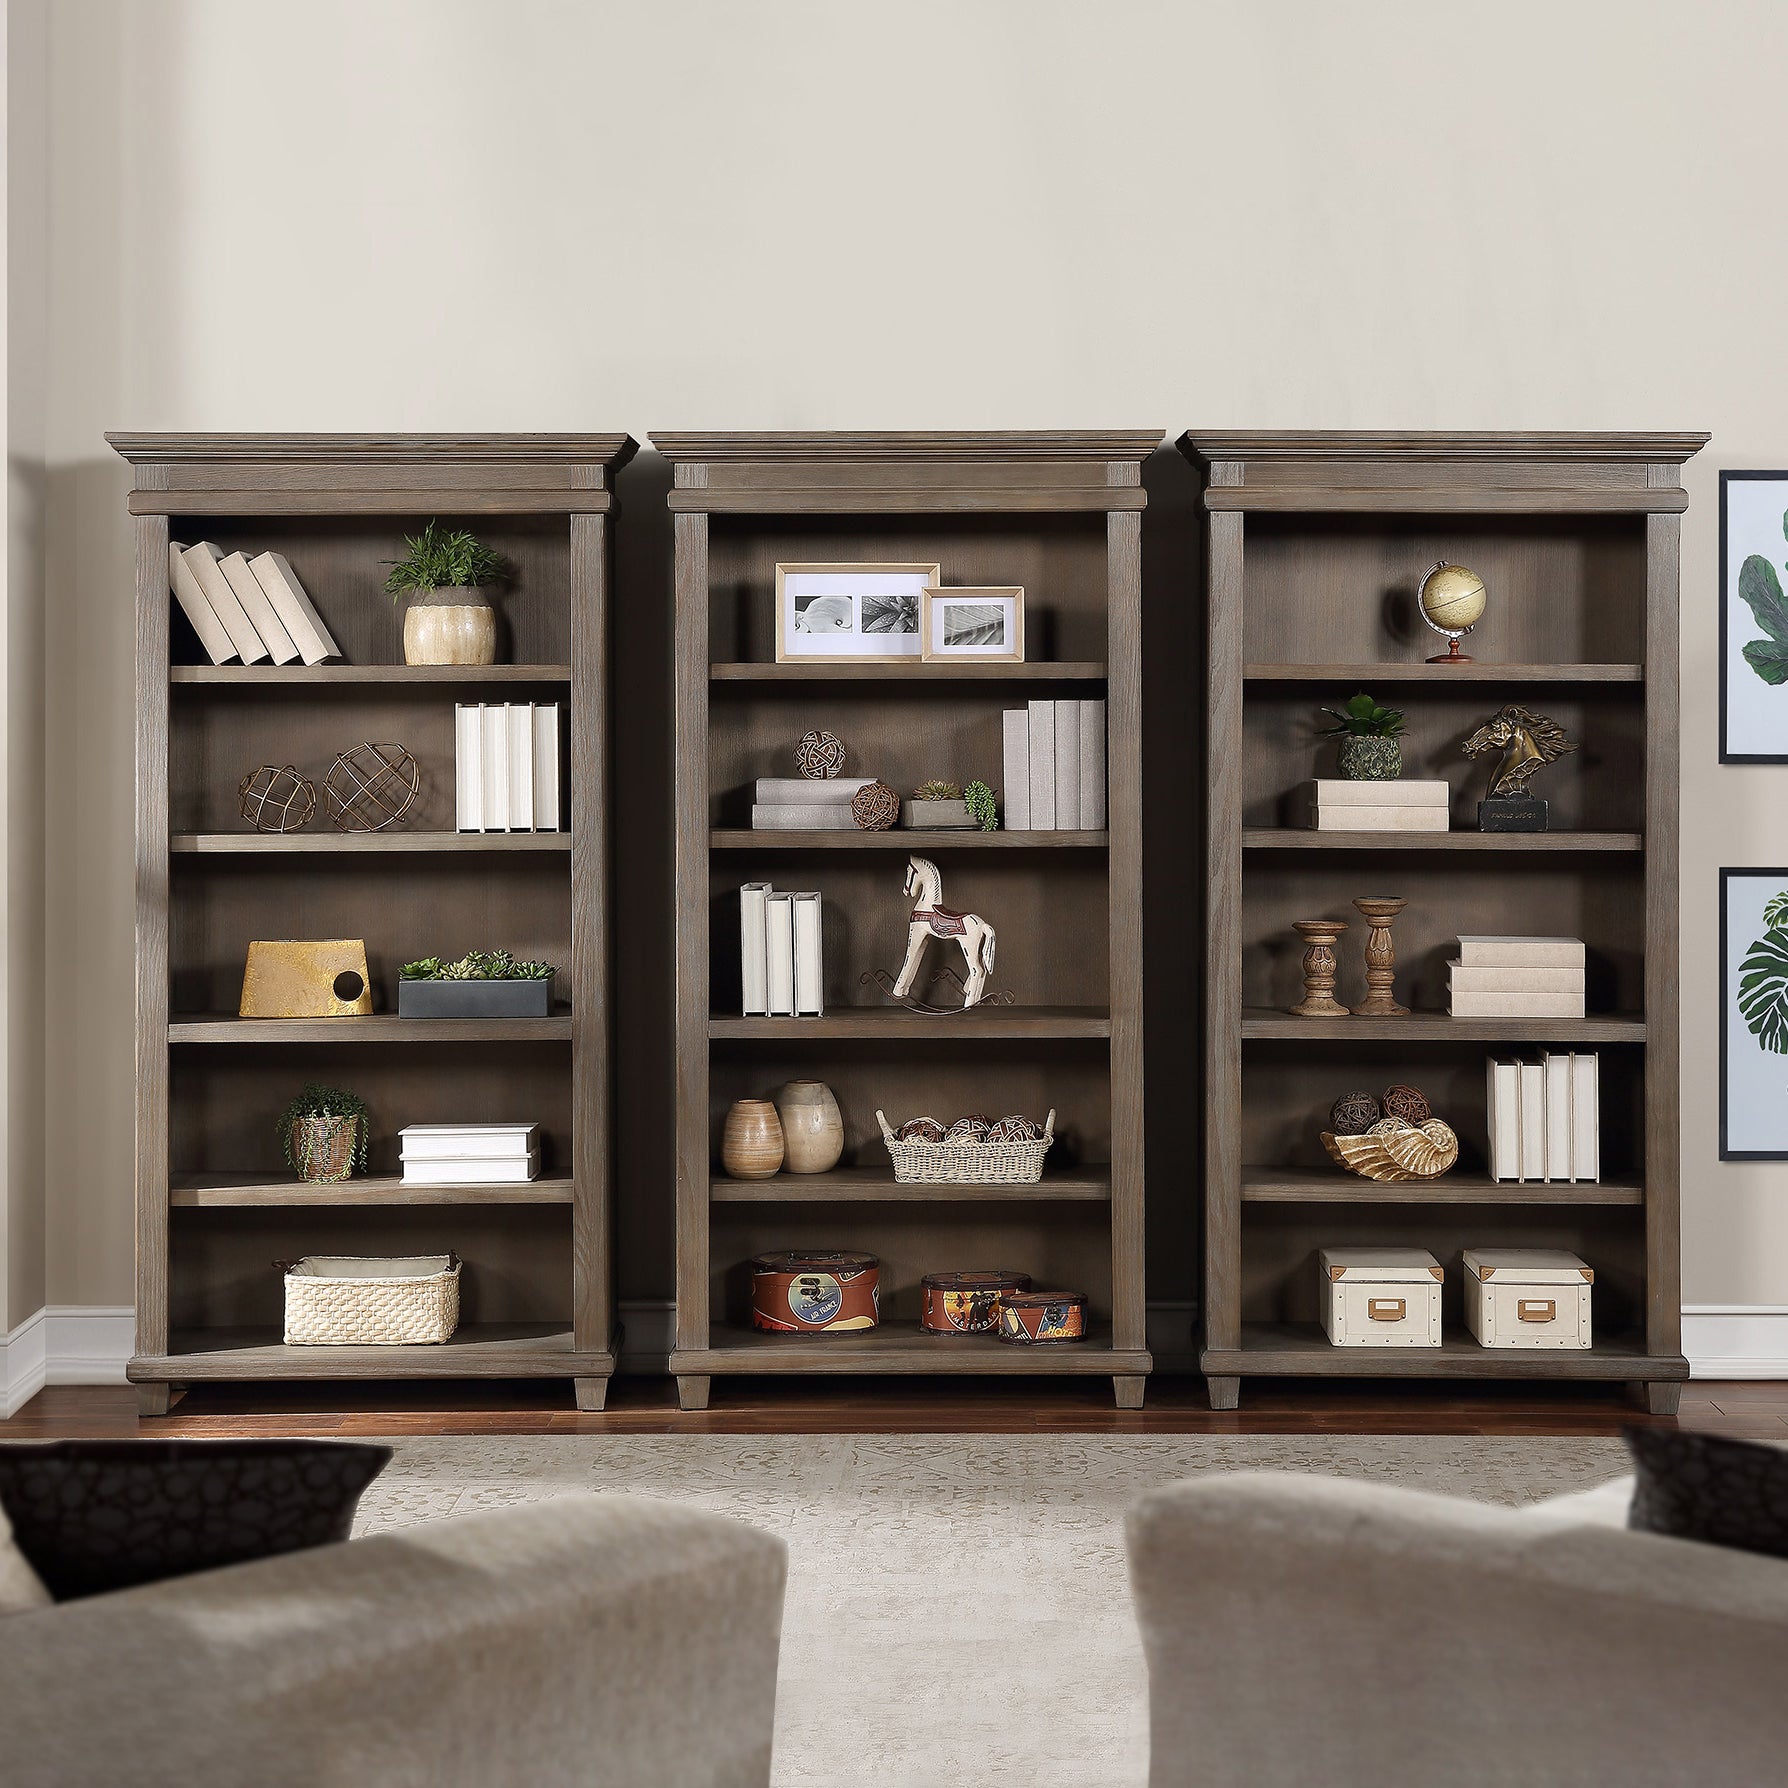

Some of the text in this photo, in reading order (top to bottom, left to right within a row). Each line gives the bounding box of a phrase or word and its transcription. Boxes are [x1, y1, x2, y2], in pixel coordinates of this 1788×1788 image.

[810, 1300, 837, 1321] AIR FRANCE
[950, 1312, 997, 1330] AMSTERDAM
